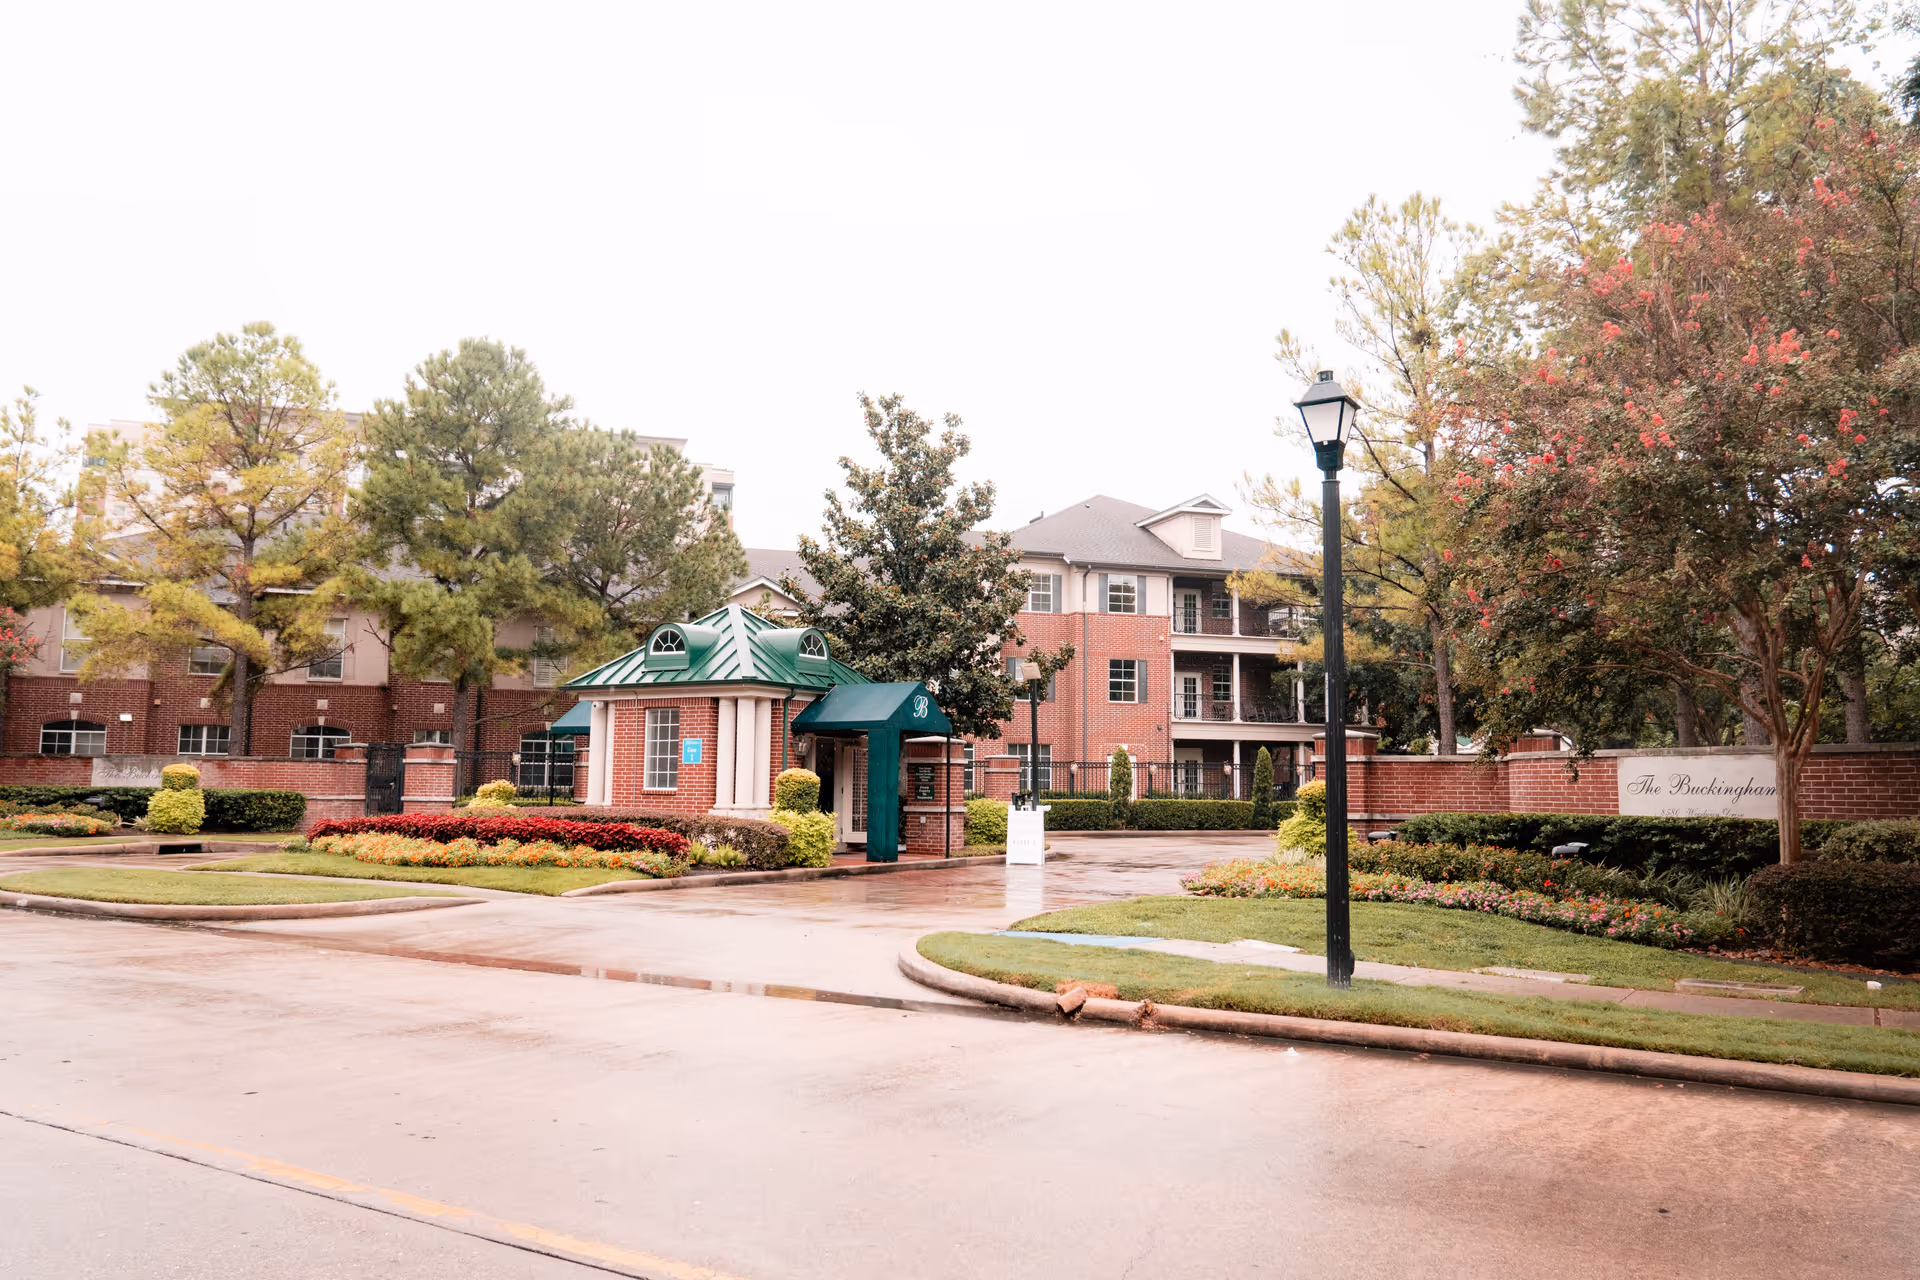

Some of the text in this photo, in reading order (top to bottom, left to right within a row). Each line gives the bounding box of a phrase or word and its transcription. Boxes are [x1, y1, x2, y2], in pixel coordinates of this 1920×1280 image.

[913, 694, 929, 718] B
[1627, 773, 1778, 804] The Buckingham
